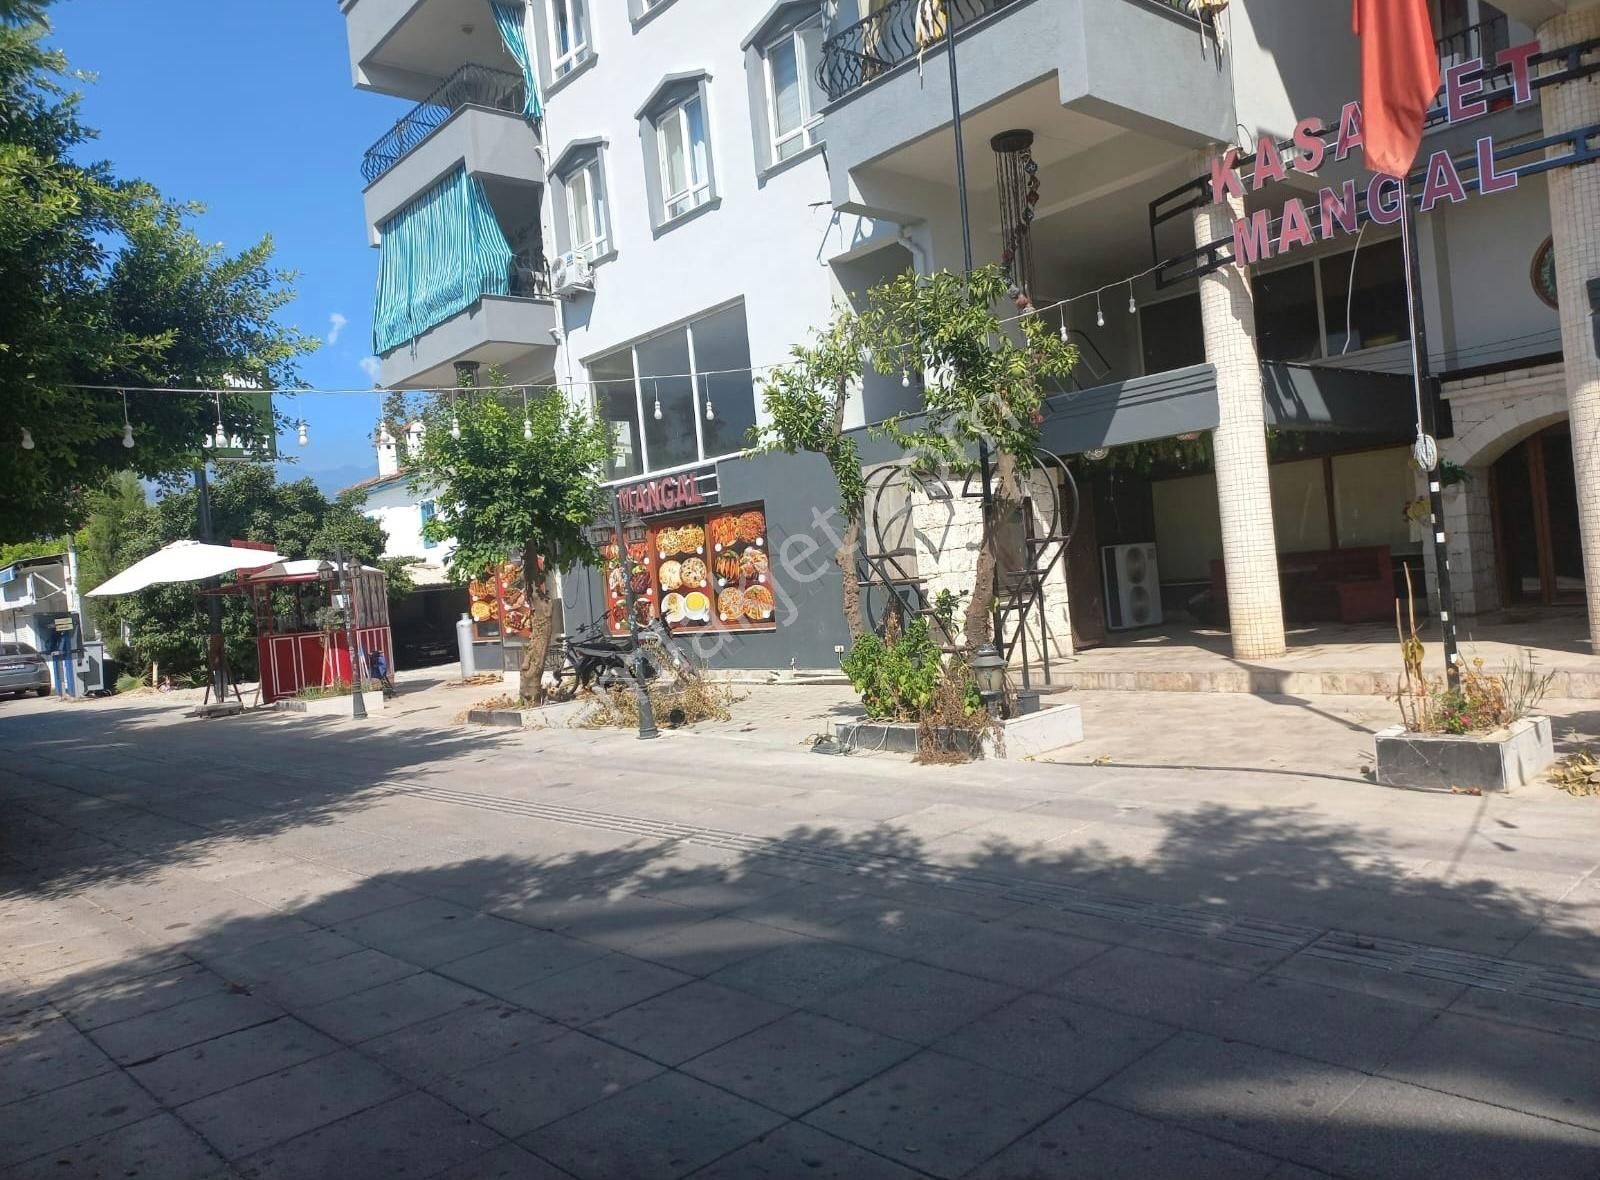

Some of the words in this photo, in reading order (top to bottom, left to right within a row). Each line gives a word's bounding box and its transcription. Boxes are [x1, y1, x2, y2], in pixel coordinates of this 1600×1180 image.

[1211, 100, 1368, 205] KASA
[1232, 136, 1518, 268] MANGAL
[618, 471, 705, 513] MANGAL
